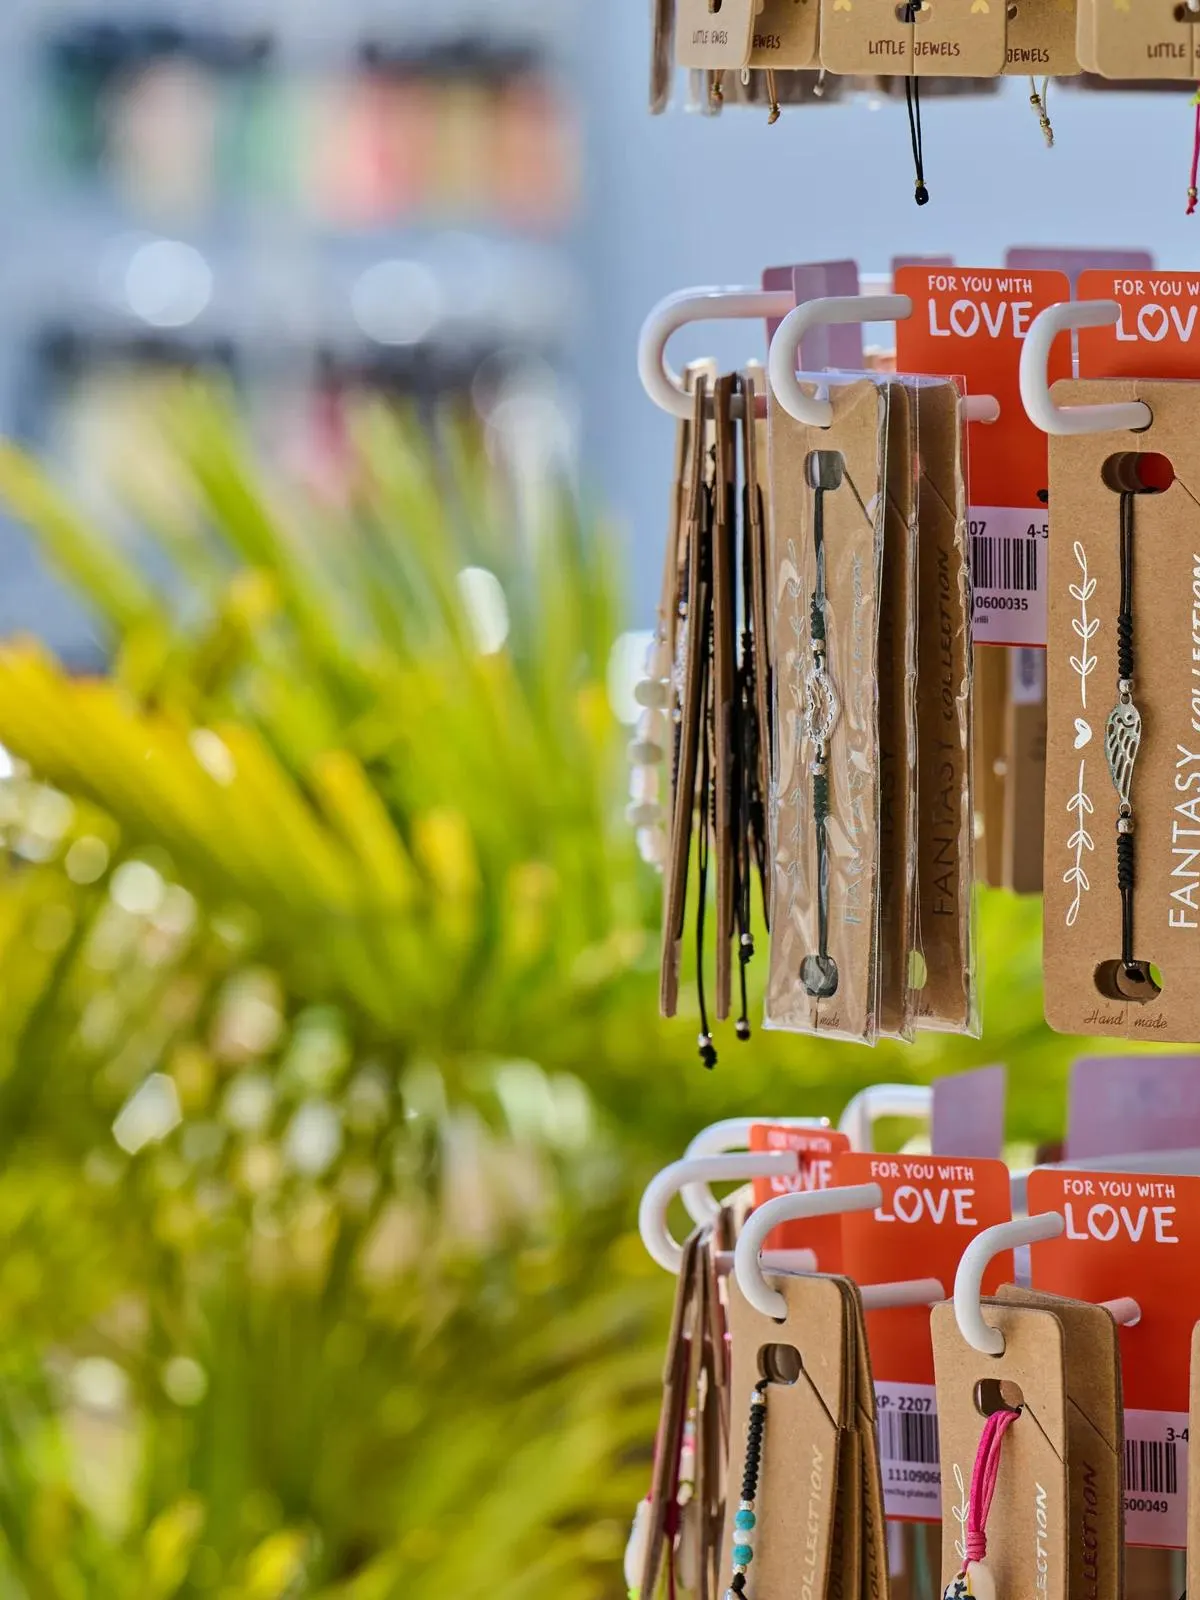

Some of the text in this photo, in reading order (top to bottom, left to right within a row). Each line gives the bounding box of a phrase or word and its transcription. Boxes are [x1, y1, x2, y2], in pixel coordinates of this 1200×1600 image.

[868, 40, 960, 56] LITTLE JEWELS
[1007, 48, 1050, 63] JEWELS
[1147, 43, 1186, 58] LITTLE
[928, 275, 1033, 293] FOR YOU WITH
[1114, 279, 1145, 295] FOR
[1149, 280, 1182, 296] YOU
[928, 299, 1033, 339] LOVE
[1027, 523, 1049, 539] 4-5
[975, 596, 1029, 611] 0600035
[1083, 1009, 1168, 1029] Hand made
[870, 1161, 974, 1181] FOR YOU WITH
[1063, 1179, 1176, 1198] FOR YOU WITH
[1064, 1202, 1180, 1243] LOVE
[898, 1397, 932, 1412] 2207
[1166, 1427, 1189, 1442] 3-4
